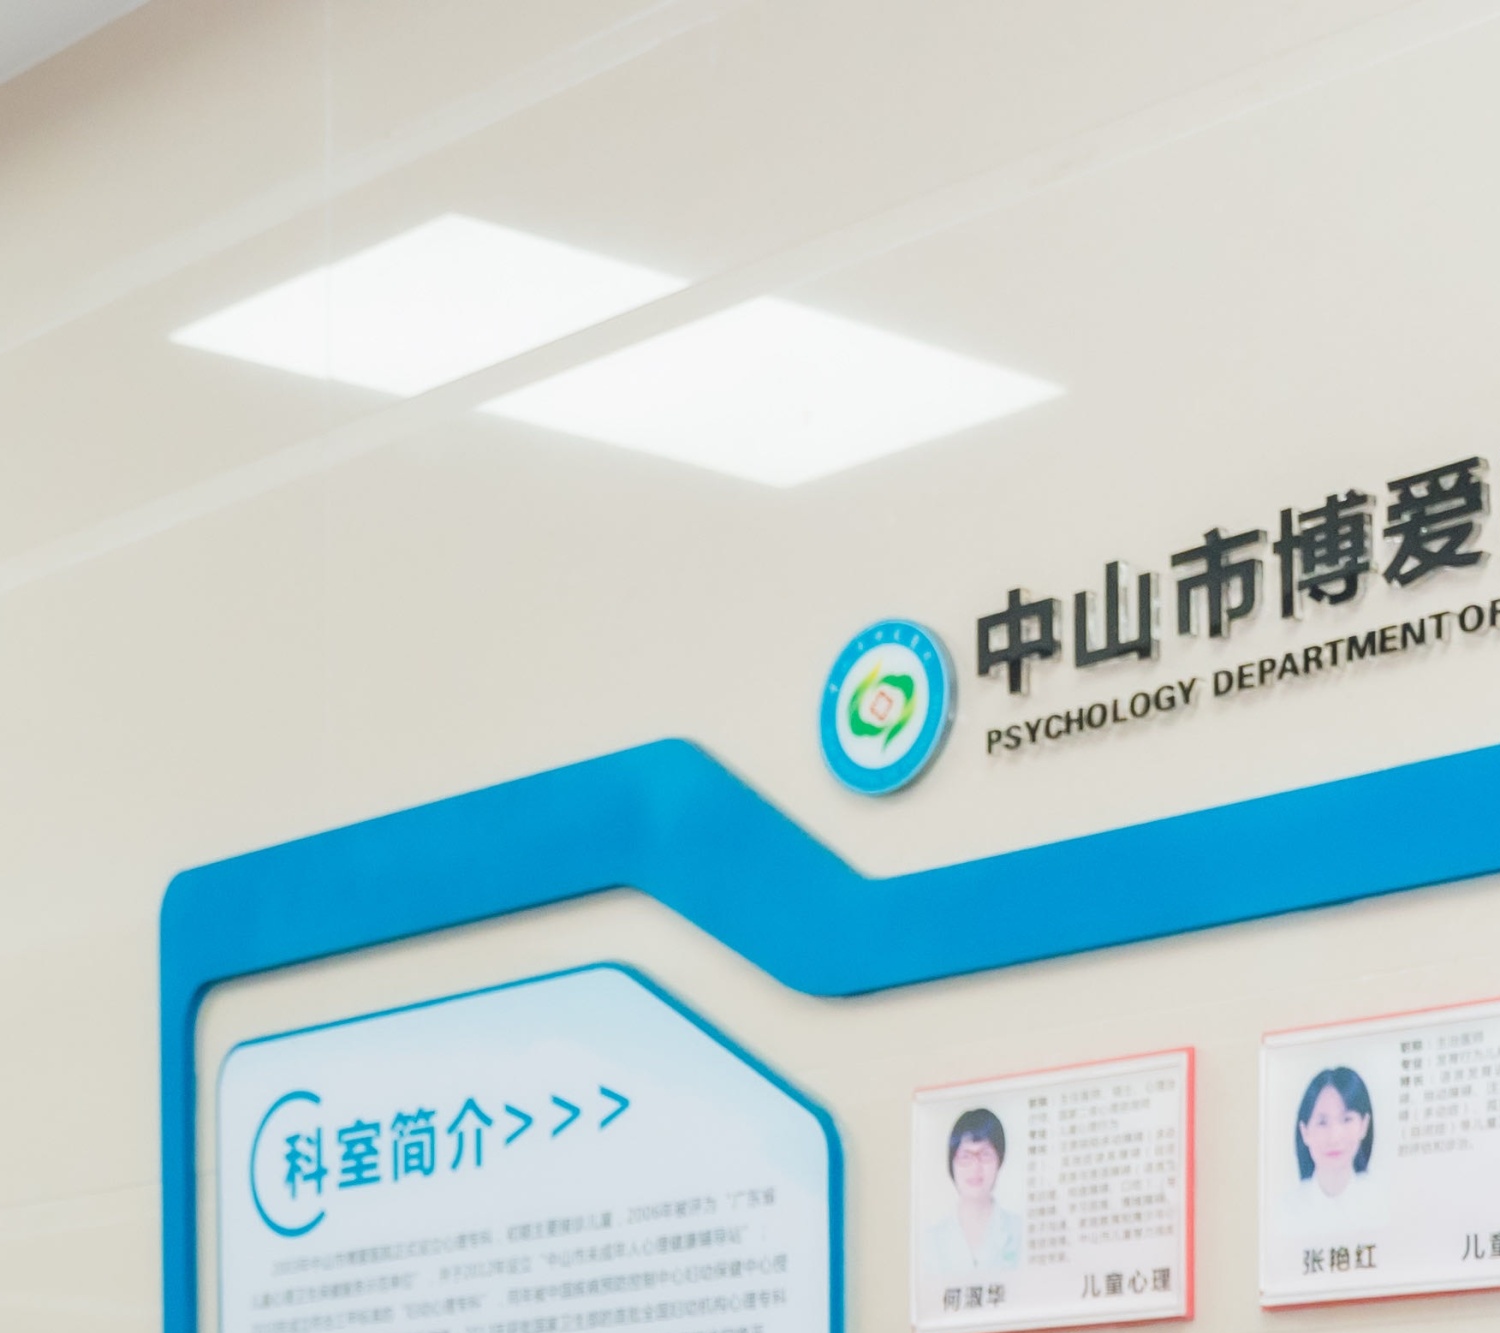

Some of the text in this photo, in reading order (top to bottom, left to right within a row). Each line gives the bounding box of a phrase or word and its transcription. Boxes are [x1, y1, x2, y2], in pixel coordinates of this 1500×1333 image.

[985, 678, 1200, 756] PSYCHOLOGY
[1212, 612, 1450, 699] DEPARTMENT
[284, 1097, 494, 1200] 科室简介
[1081, 1267, 1172, 1299] 儿童心理
[1302, 1243, 1379, 1274] 张艳红
